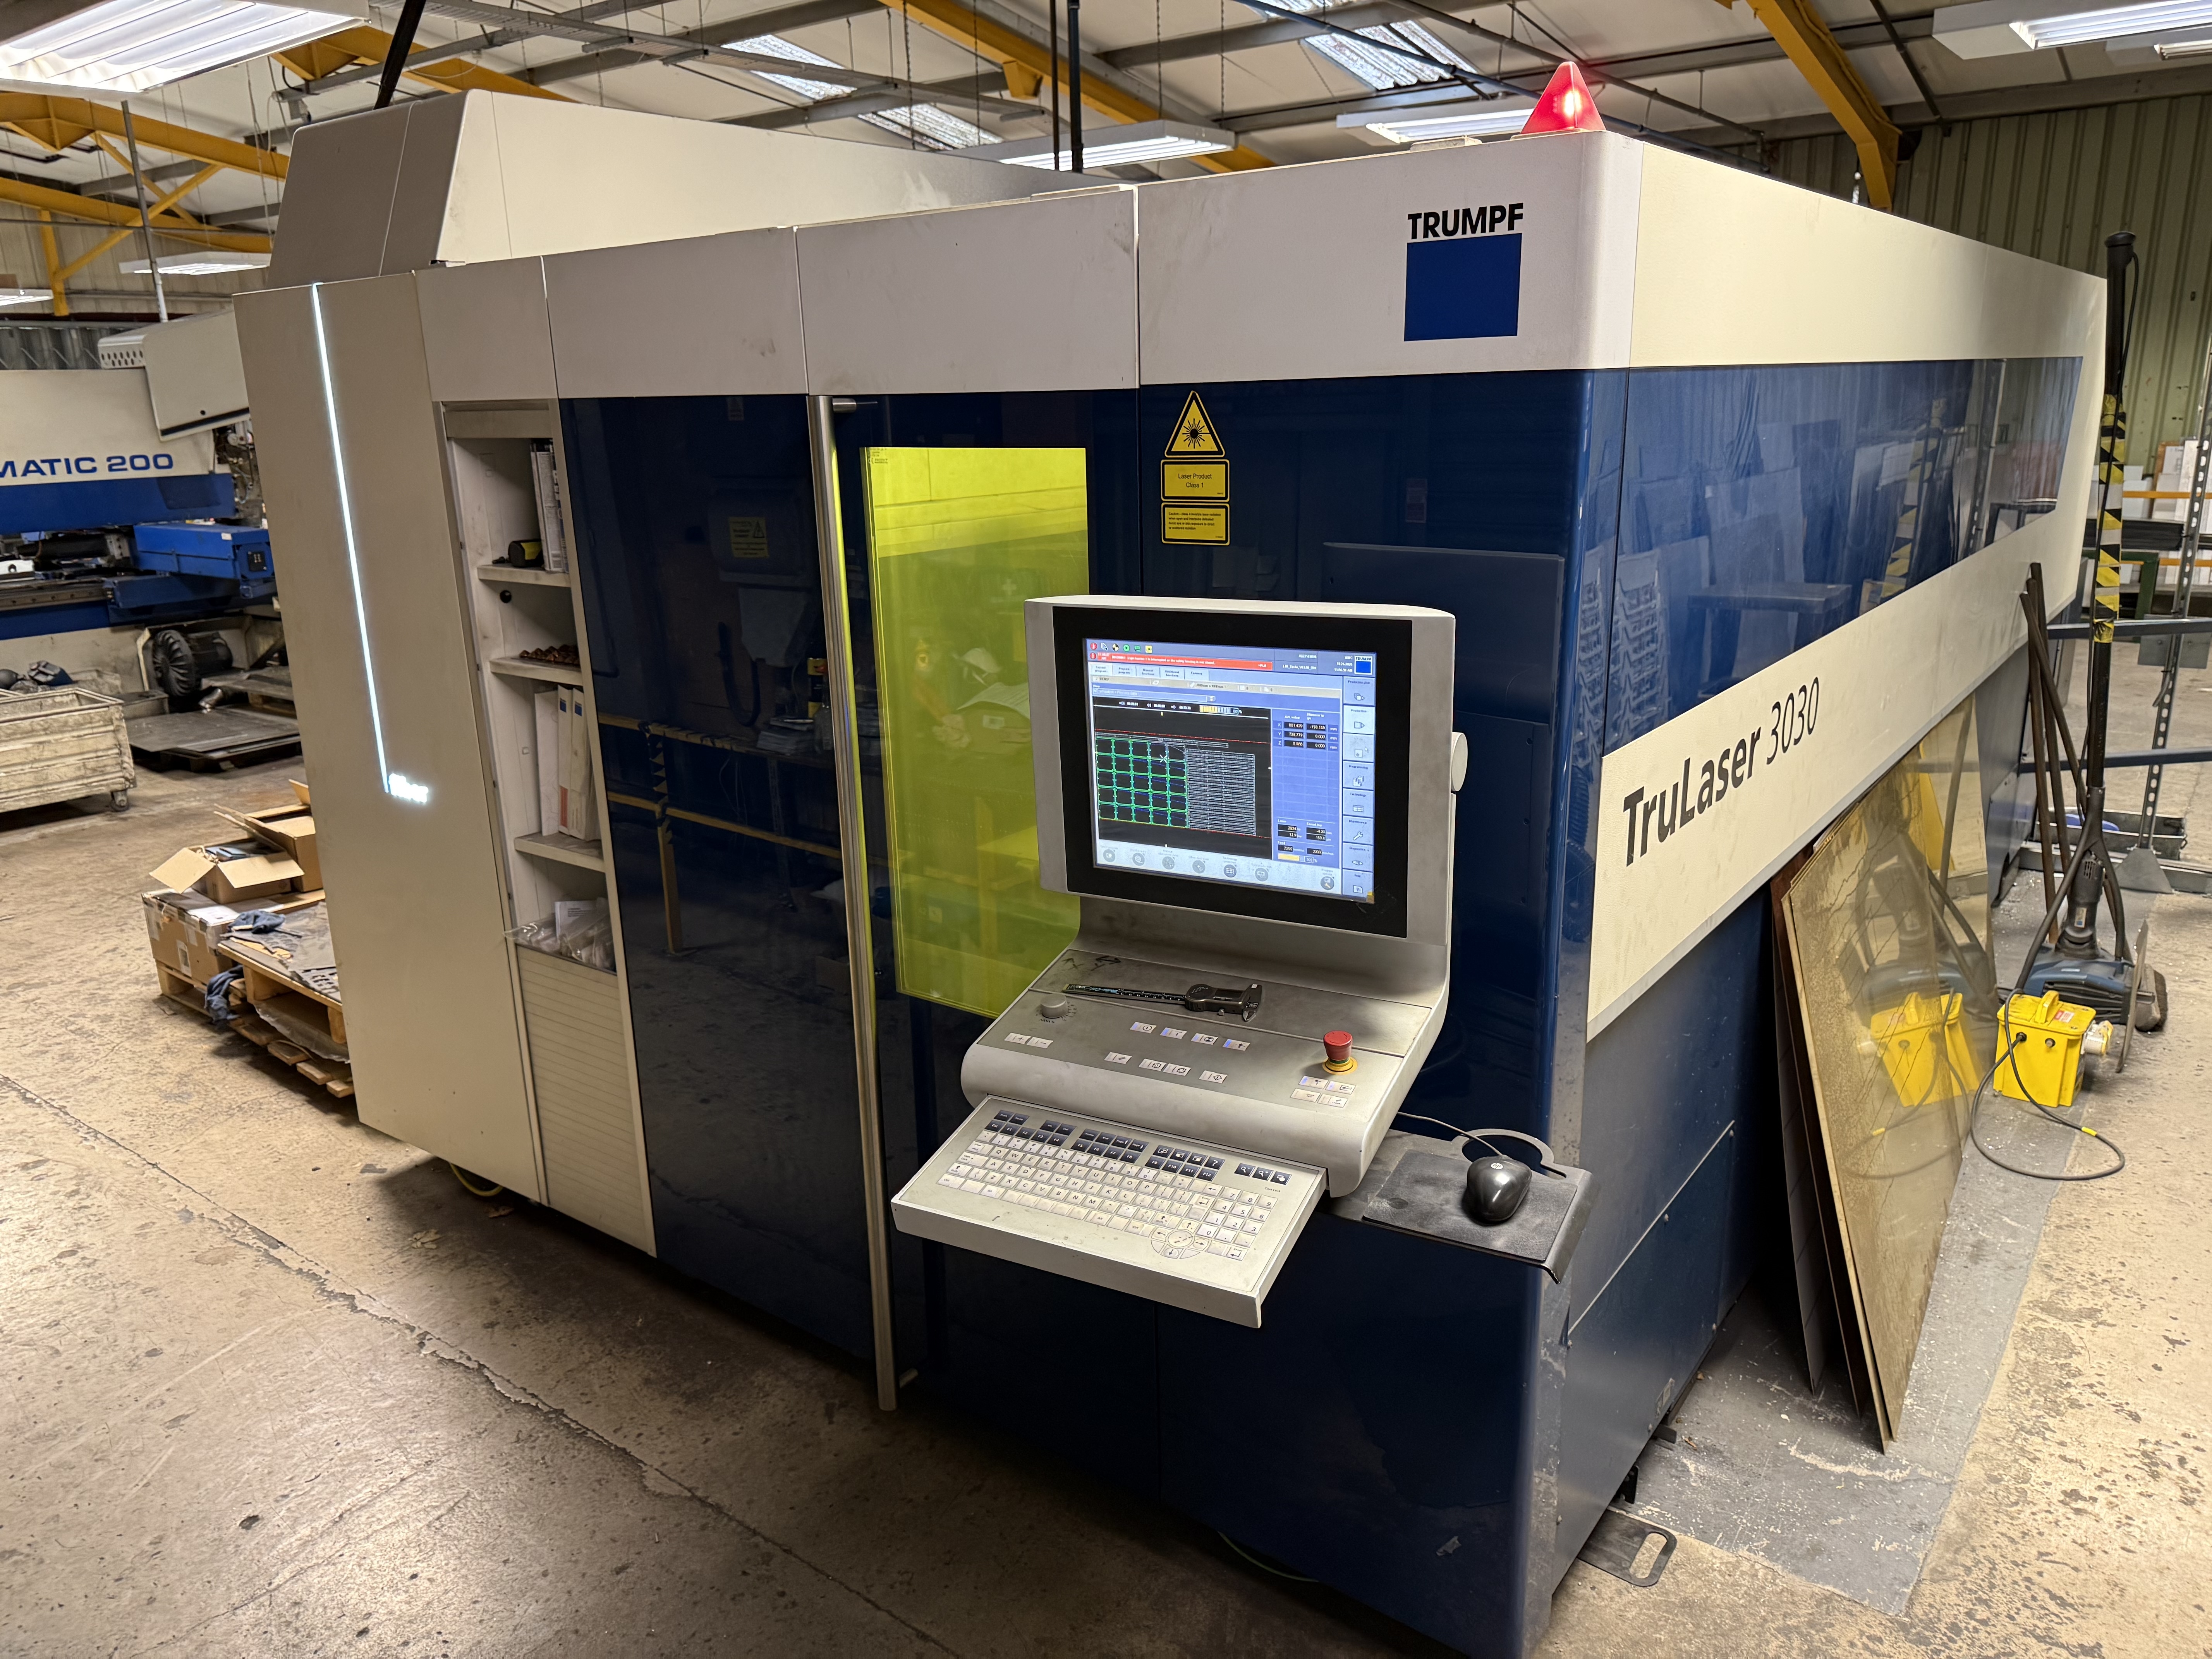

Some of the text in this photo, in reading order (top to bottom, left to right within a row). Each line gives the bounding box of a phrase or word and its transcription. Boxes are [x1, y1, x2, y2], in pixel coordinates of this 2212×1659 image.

[1408, 203, 1523, 239] TRUMPF
[0, 453, 173, 478] MATIC 200
[1623, 677, 1819, 867] TruLaser 3030
